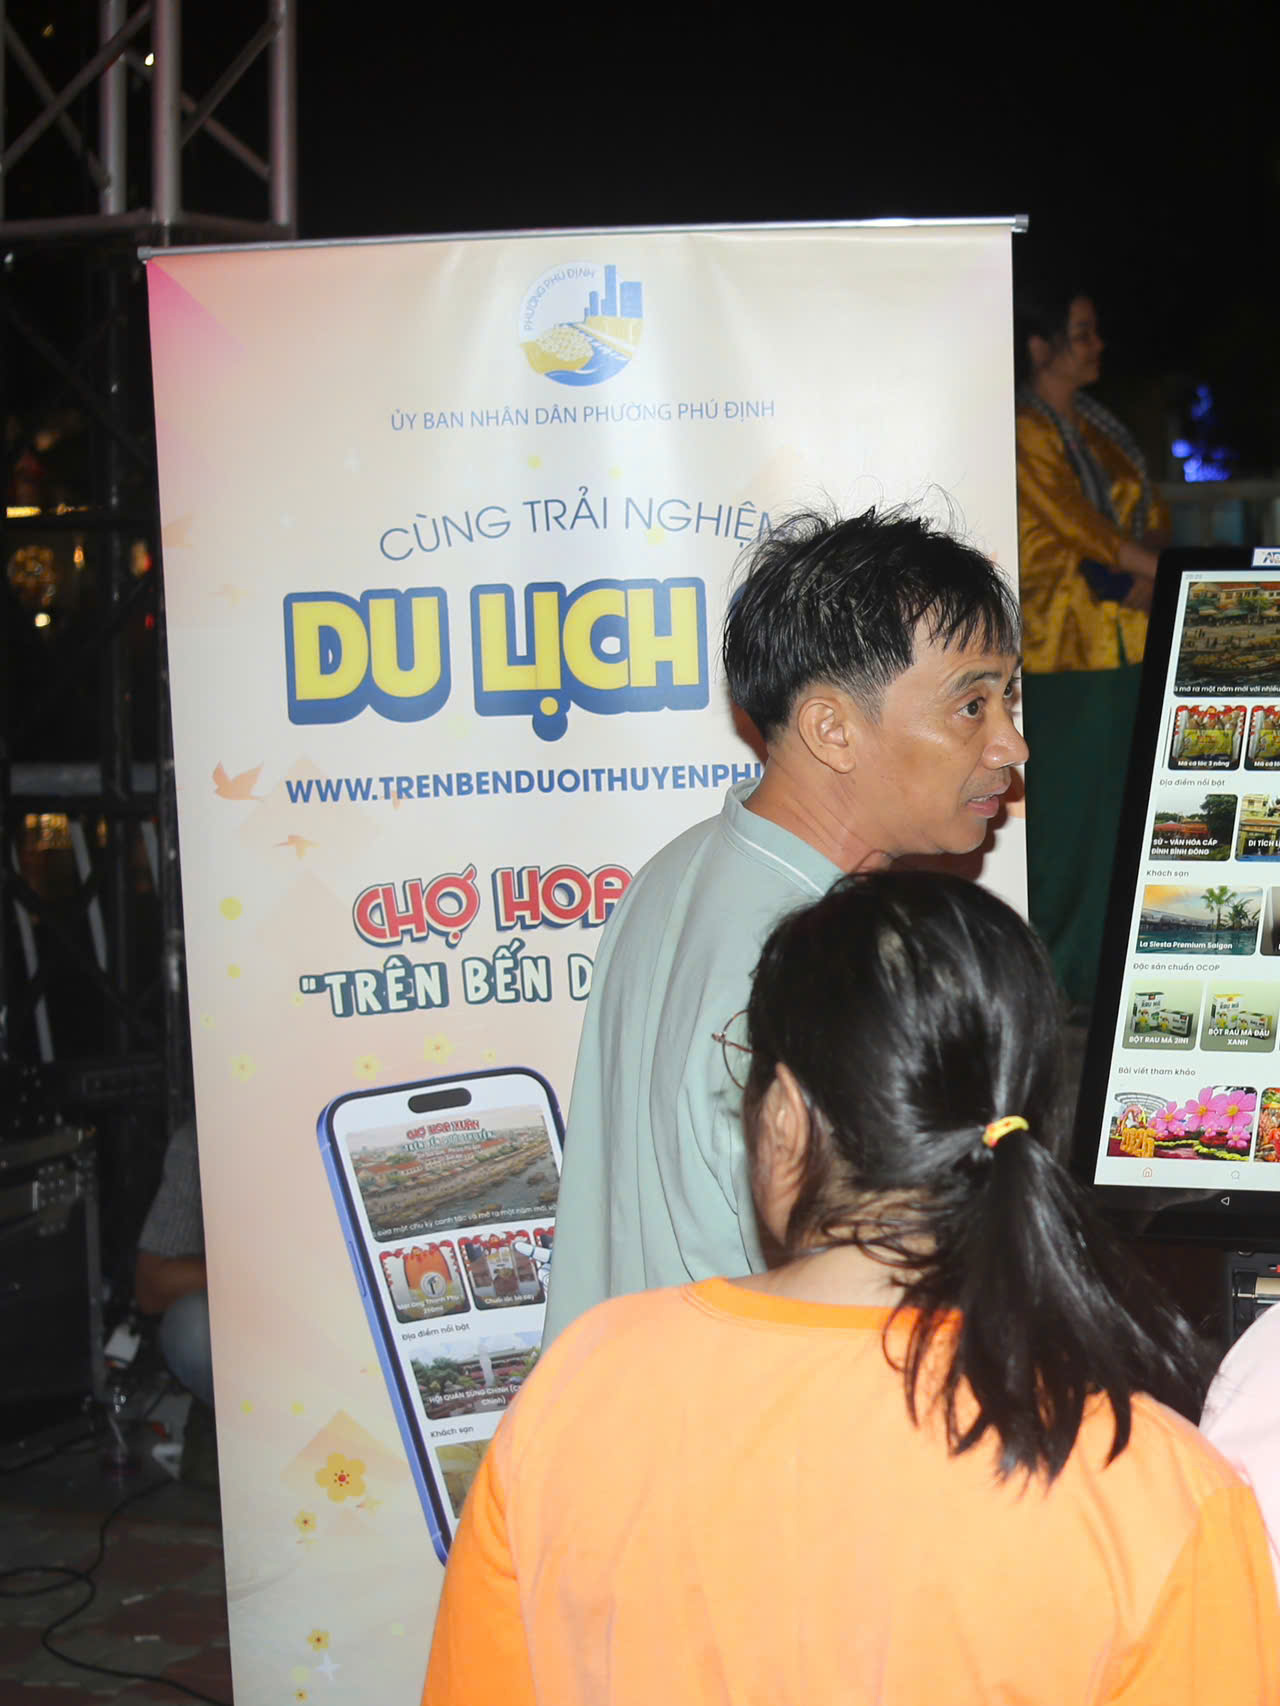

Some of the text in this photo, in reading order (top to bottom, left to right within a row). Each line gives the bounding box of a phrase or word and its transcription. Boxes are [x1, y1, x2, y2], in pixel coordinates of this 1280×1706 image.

[391, 398, 776, 431] ỦY BAN NHÂN DÂN PHƯỜNG PHÚ ĐỊNH
[380, 506, 512, 562] CÙNG
[523, 486, 608, 533] TRẢI
[286, 582, 704, 730] DU LỊCH
[1146, 869, 1172, 877] Khách
[353, 863, 634, 948] CHỢ HOA
[1172, 941, 1206, 949] Premium
[1207, 942, 1233, 950] Saigon
[300, 937, 595, 1017] "TRÊN BẾN D
[1129, 1035, 1143, 1044] BỘT
[1144, 1036, 1160, 1044] RAU
[1118, 1066, 1131, 1074] Bài
[1150, 1067, 1173, 1075] tham
